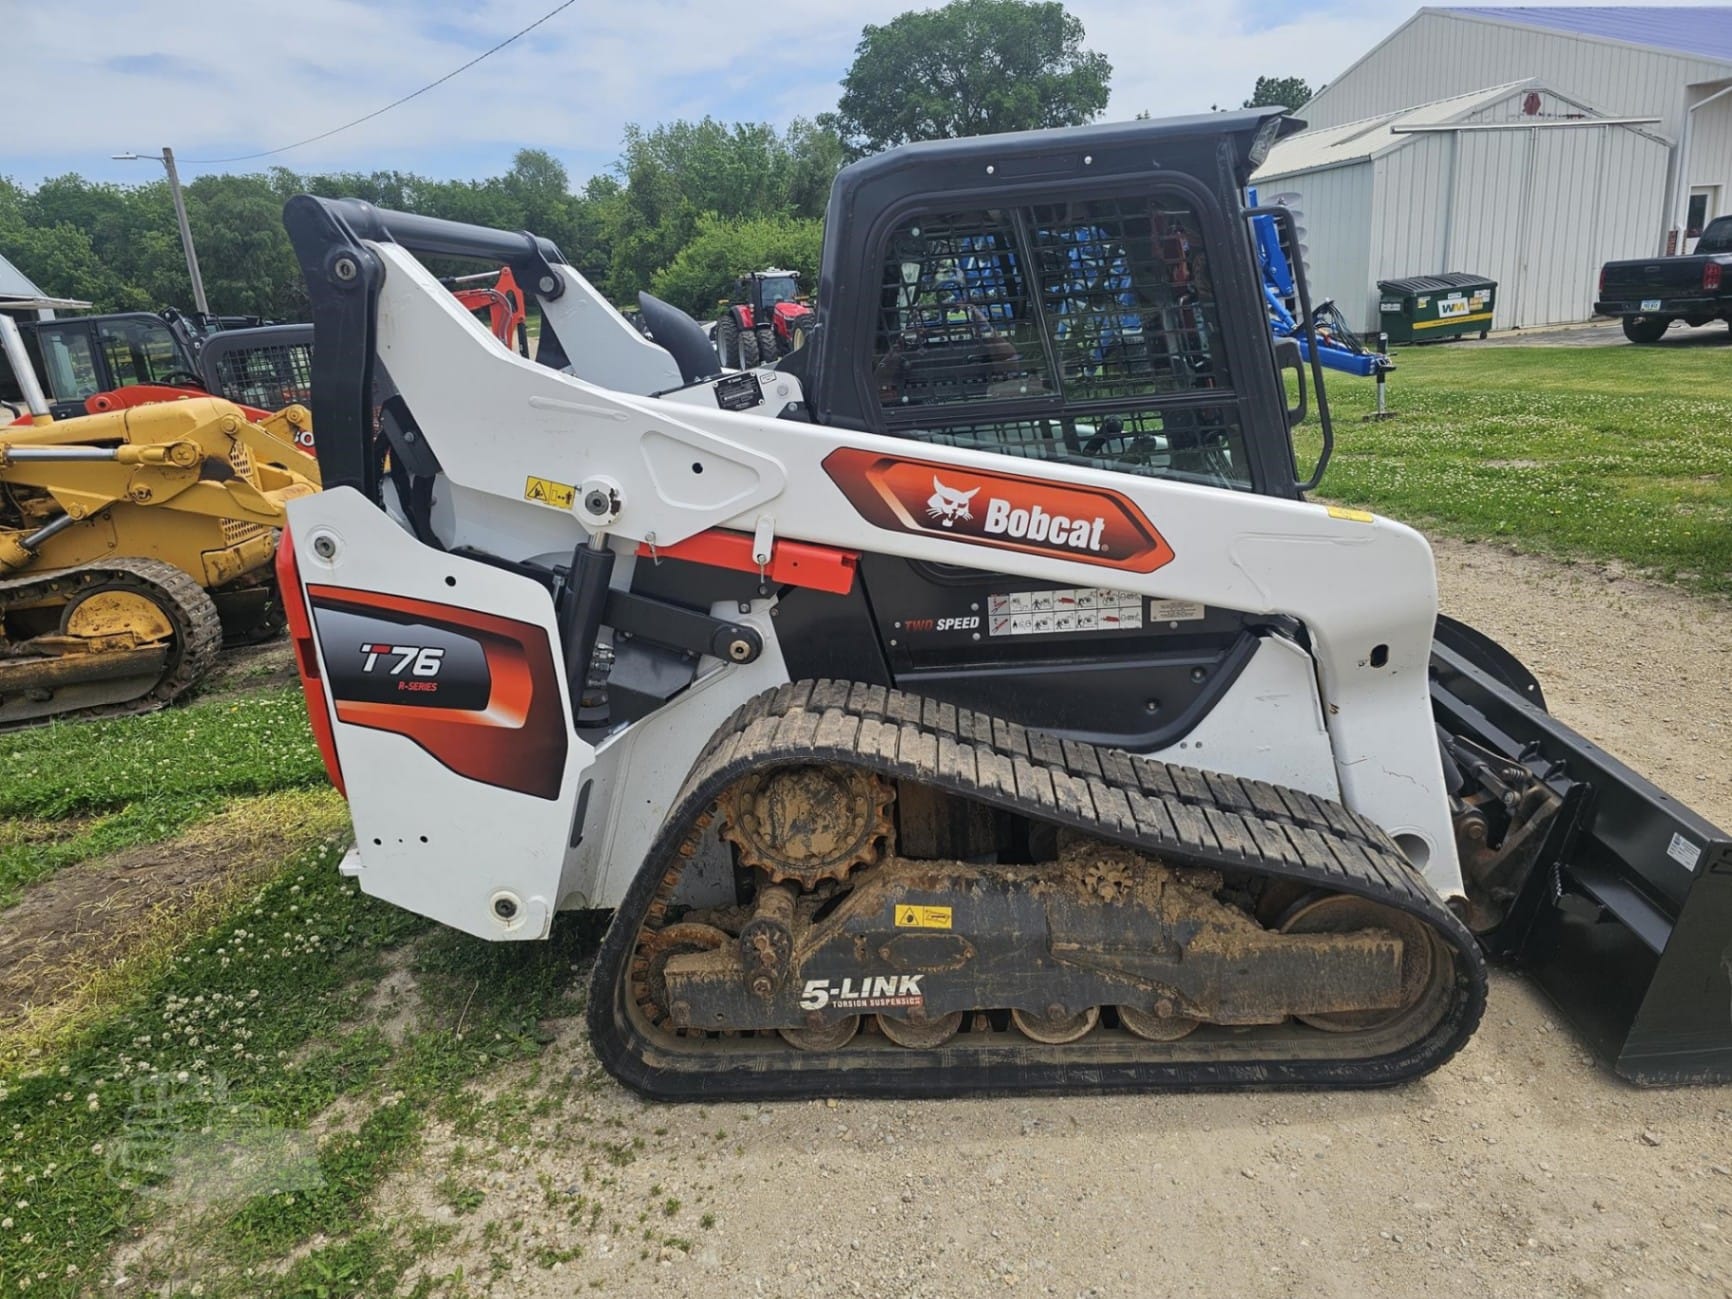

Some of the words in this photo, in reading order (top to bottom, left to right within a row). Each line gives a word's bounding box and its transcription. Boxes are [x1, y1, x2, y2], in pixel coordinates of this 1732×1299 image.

[1442, 302, 1466, 314] WM
[984, 497, 1105, 552] Bobcat
[904, 619, 934, 631] TWO
[936, 616, 980, 631] SPEED
[361, 644, 444, 676] T76
[398, 682, 438, 692] R-SERIES
[799, 974, 925, 1011] 5-LINK
[832, 1000, 867, 1008] TORSION
